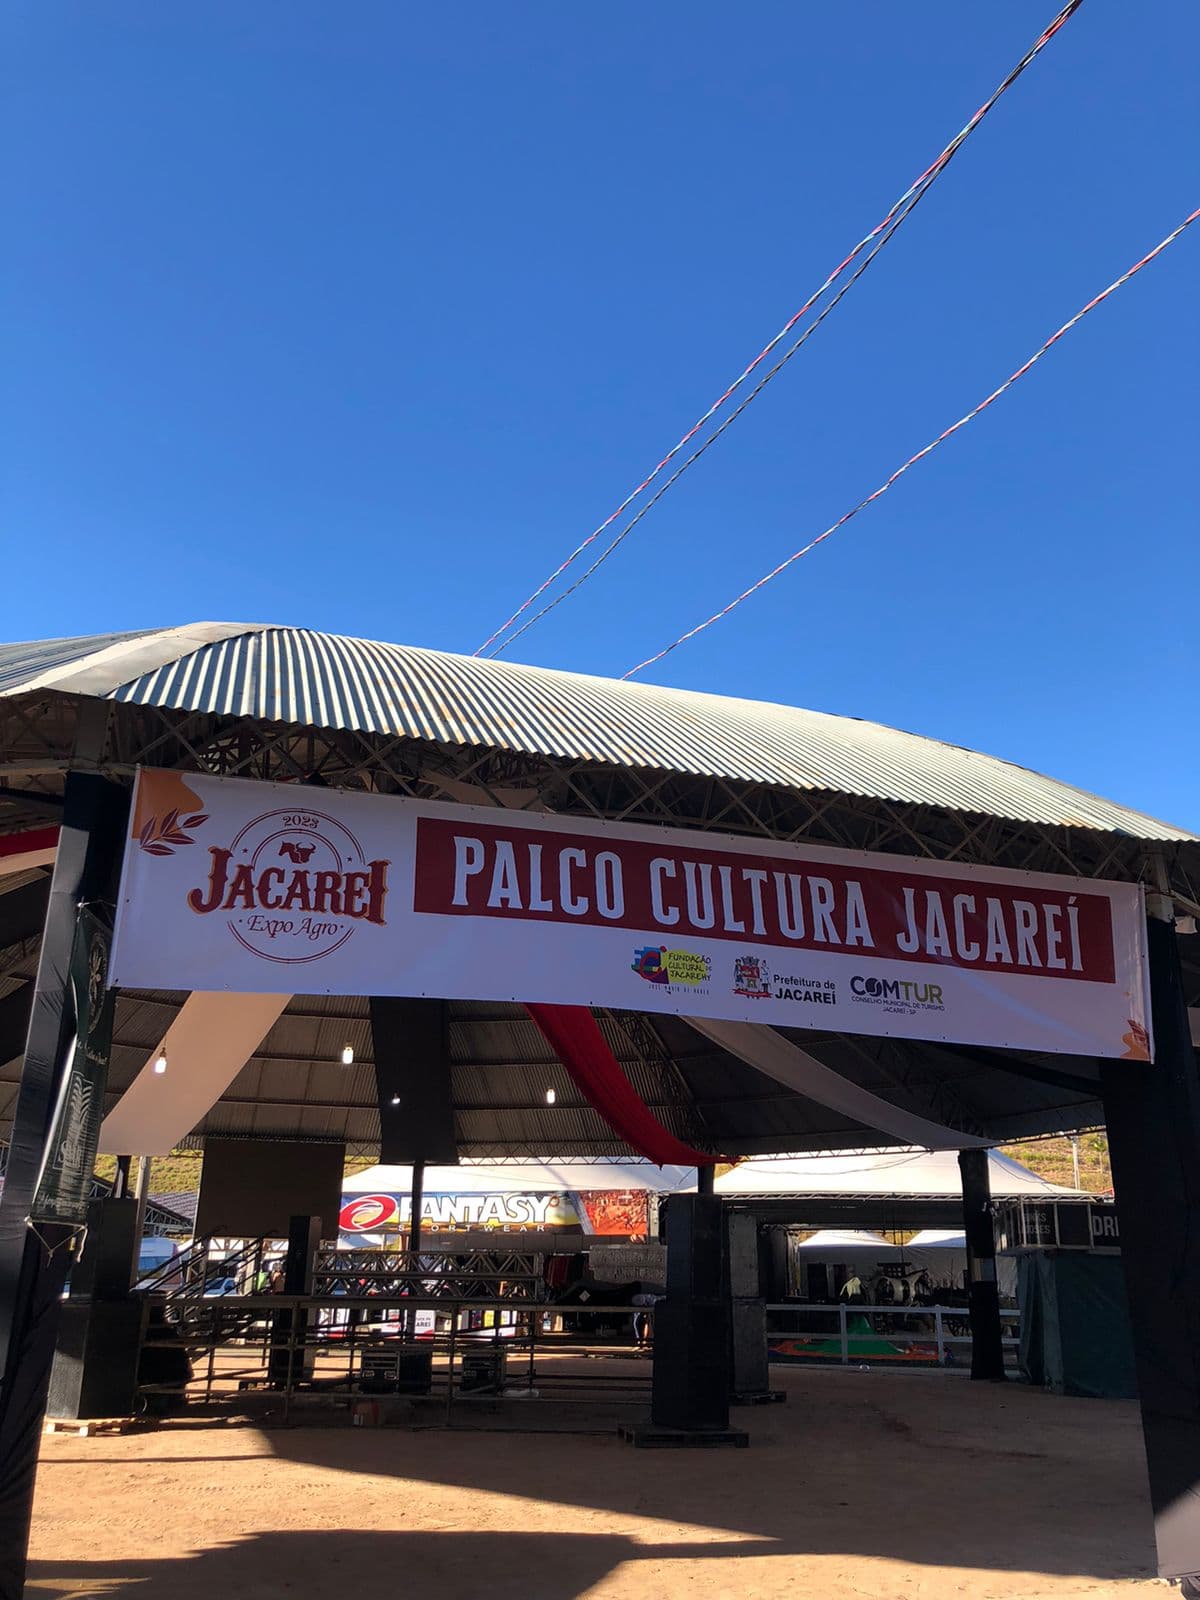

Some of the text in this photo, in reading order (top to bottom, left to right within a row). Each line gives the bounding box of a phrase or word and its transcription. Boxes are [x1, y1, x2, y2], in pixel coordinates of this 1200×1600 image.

[282, 815, 320, 830] 2023
[451, 836, 1084, 972] PALCO CULTURA JACAREÍ
[247, 914, 338, 941] Expo Agro
[668, 961, 704, 972] CULTURAL
[670, 970, 711, 981] JACAREHY
[773, 974, 836, 990] Prefeitura de
[774, 988, 836, 1005] JACAREÍ
[850, 975, 943, 1004] COMTUR
[851, 996, 882, 1005] CONSELHO
[882, 999, 912, 1008] MUNICIPAL
[399, 1195, 550, 1223] FANTASY
[398, 1224, 545, 1232] SORTWEAR
